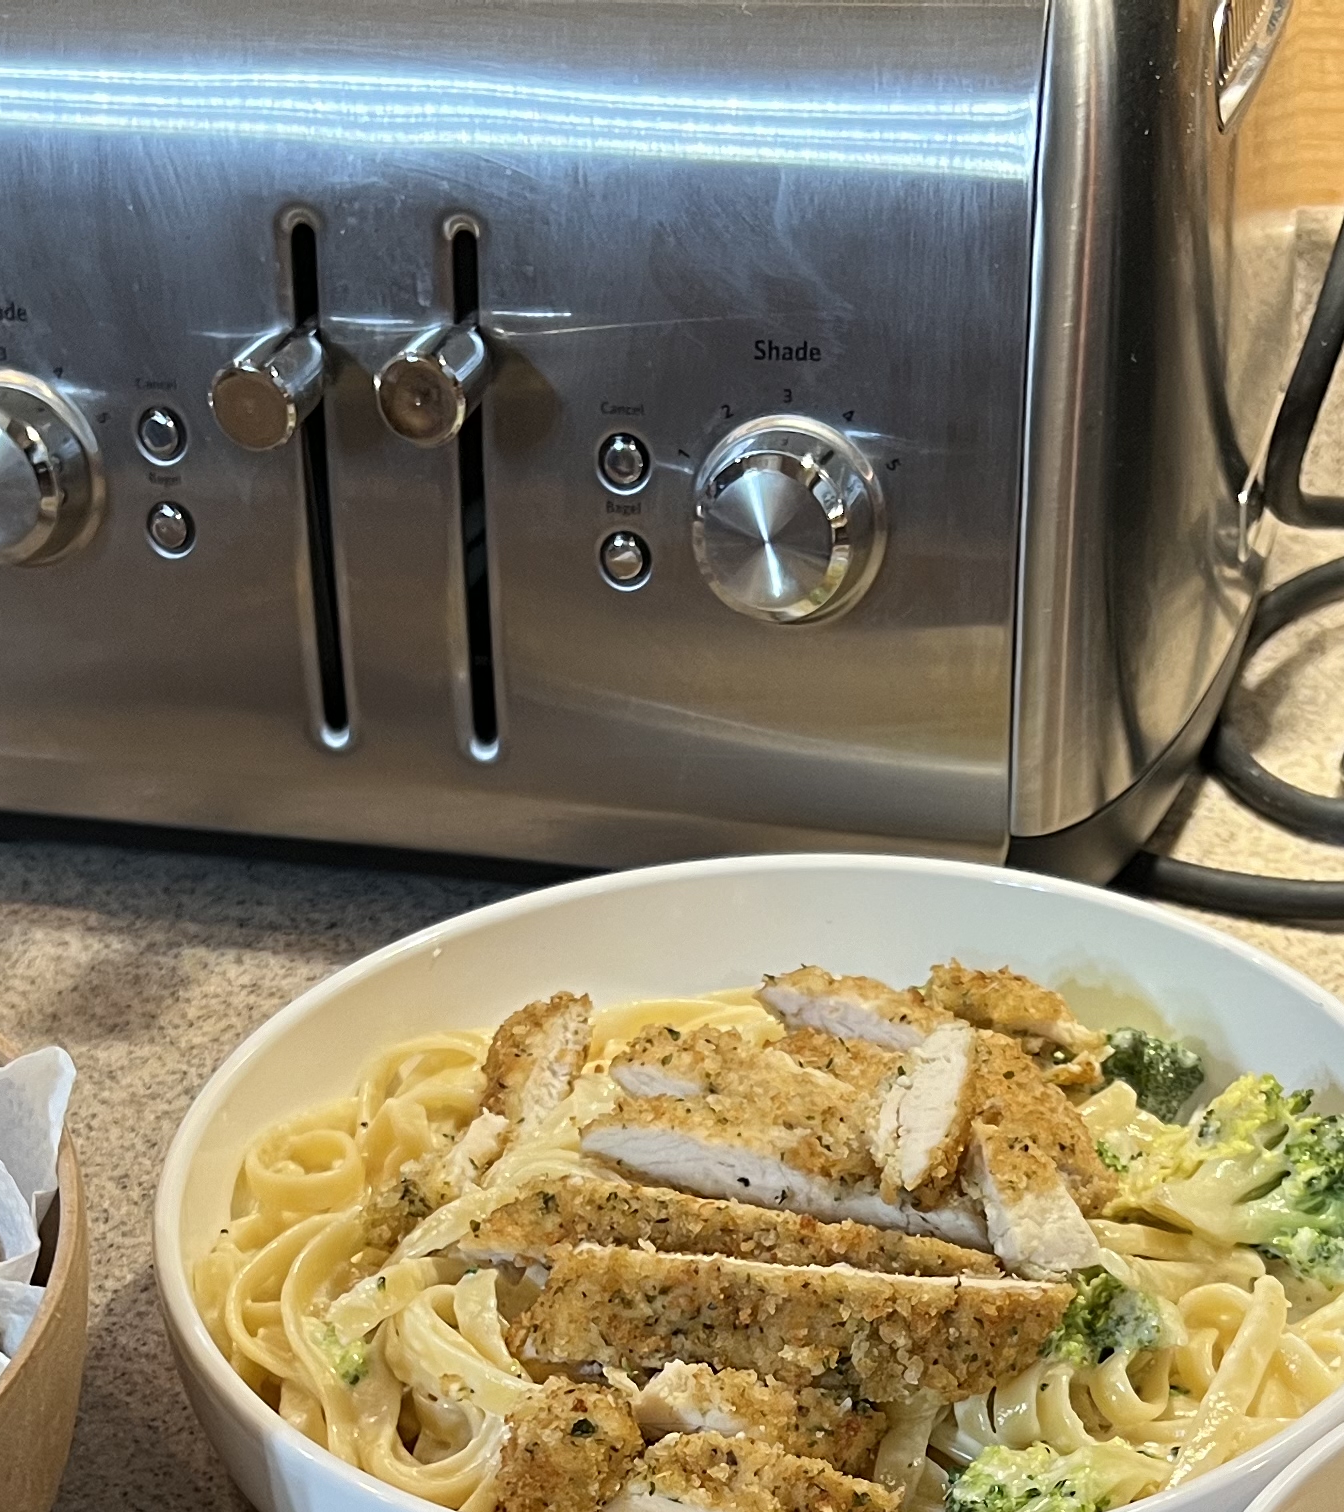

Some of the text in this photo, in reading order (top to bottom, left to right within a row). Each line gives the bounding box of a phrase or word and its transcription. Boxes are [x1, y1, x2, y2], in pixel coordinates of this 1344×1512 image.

[754, 340, 822, 362] Shade
[783, 389, 793, 404] 3
[600, 402, 645, 416] Cancel
[721, 404, 734, 419] 2
[842, 410, 855, 422] 4
[885, 457, 901, 471] 5
[606, 501, 642, 515] Bagel
